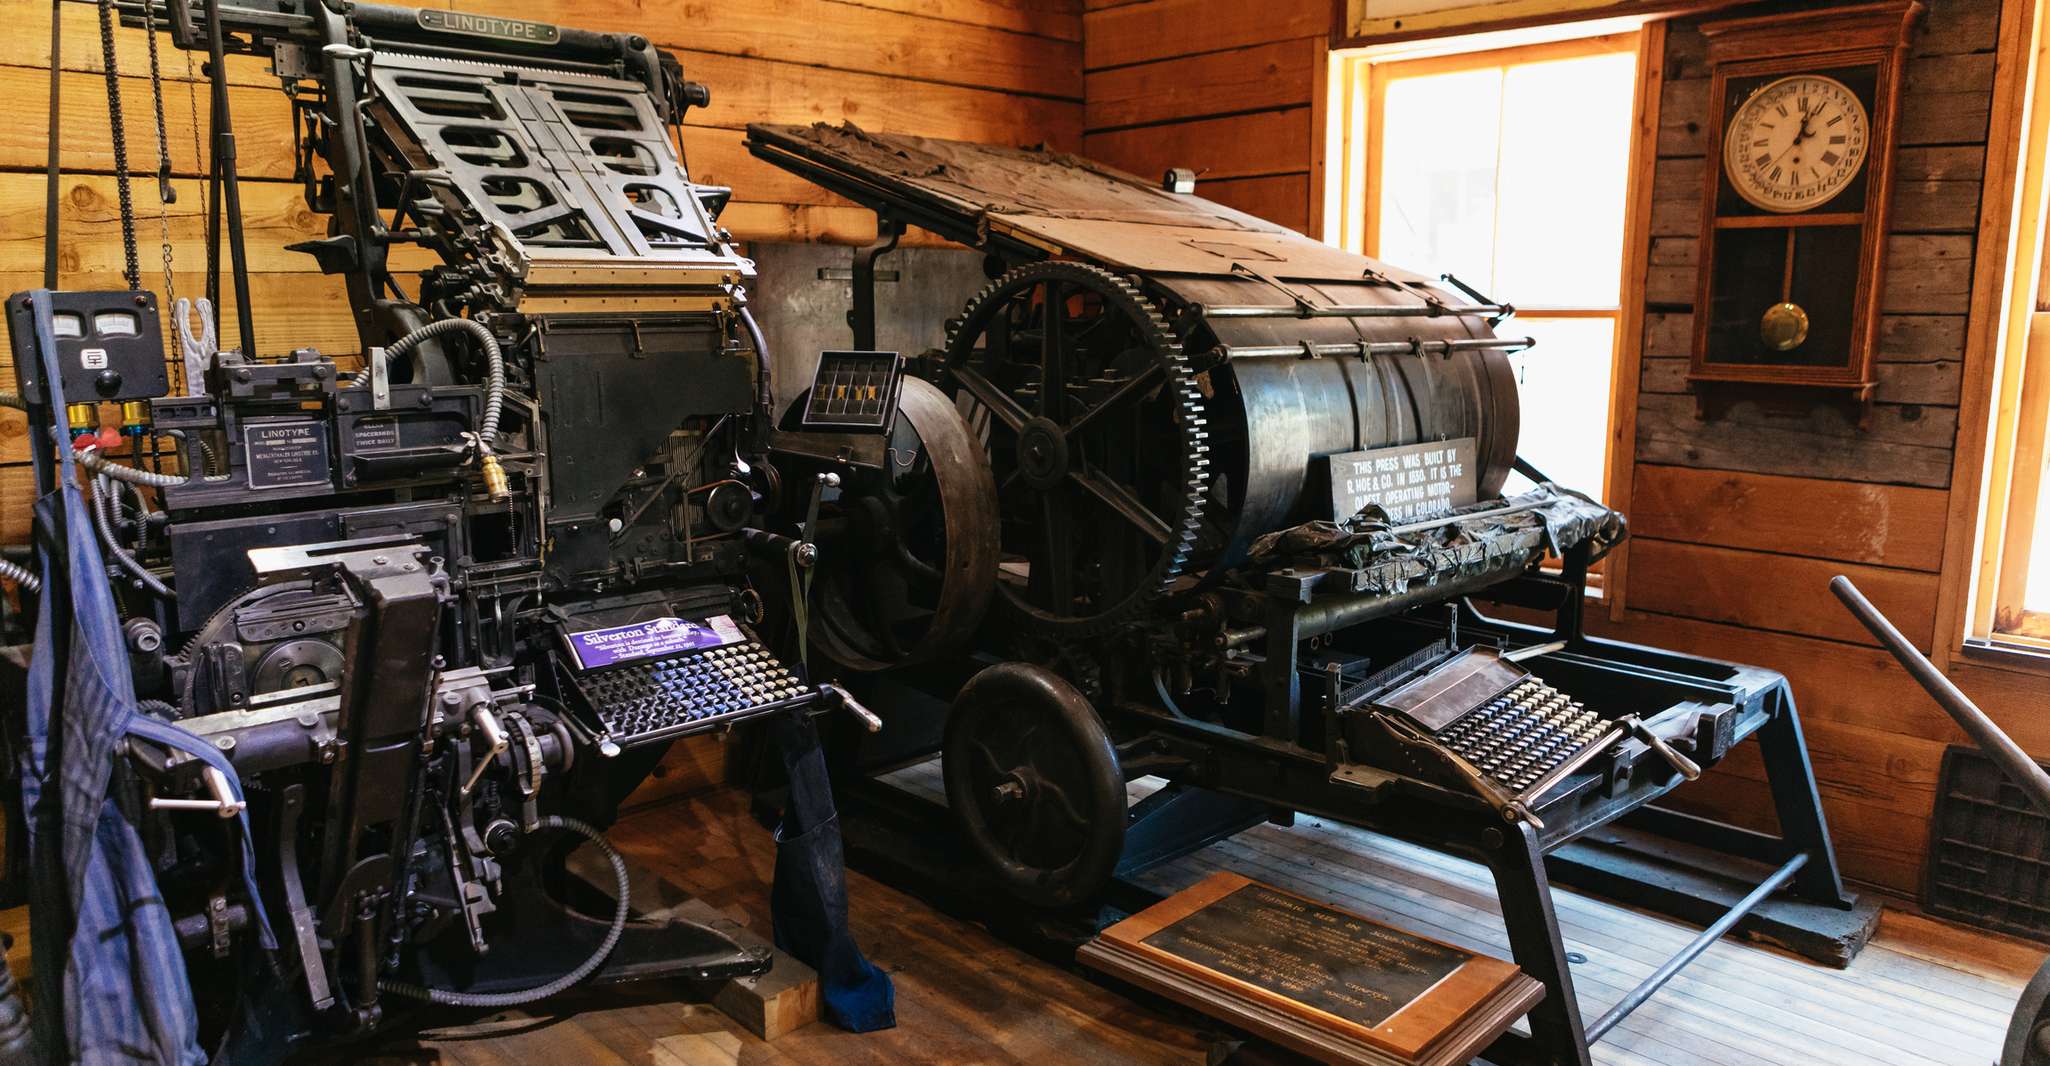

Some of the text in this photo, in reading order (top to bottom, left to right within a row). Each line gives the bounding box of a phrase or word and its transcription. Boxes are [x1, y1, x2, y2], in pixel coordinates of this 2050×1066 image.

[443, 13, 536, 38] LINOTYPE
[262, 428, 310, 439] LINOTYPE
[1353, 448, 1456, 475] THIS PRESS WAS BUILT BY
[1356, 477, 1372, 491] HOE
[1373, 478, 1379, 490] &
[1397, 473, 1405, 486] IN
[1431, 468, 1437, 480] IT
[1440, 466, 1447, 478] IS
[1450, 464, 1462, 476] THE
[1386, 486, 1424, 505] OPERATING
[1406, 504, 1413, 517] IN
[583, 629, 644, 646] Silverton
